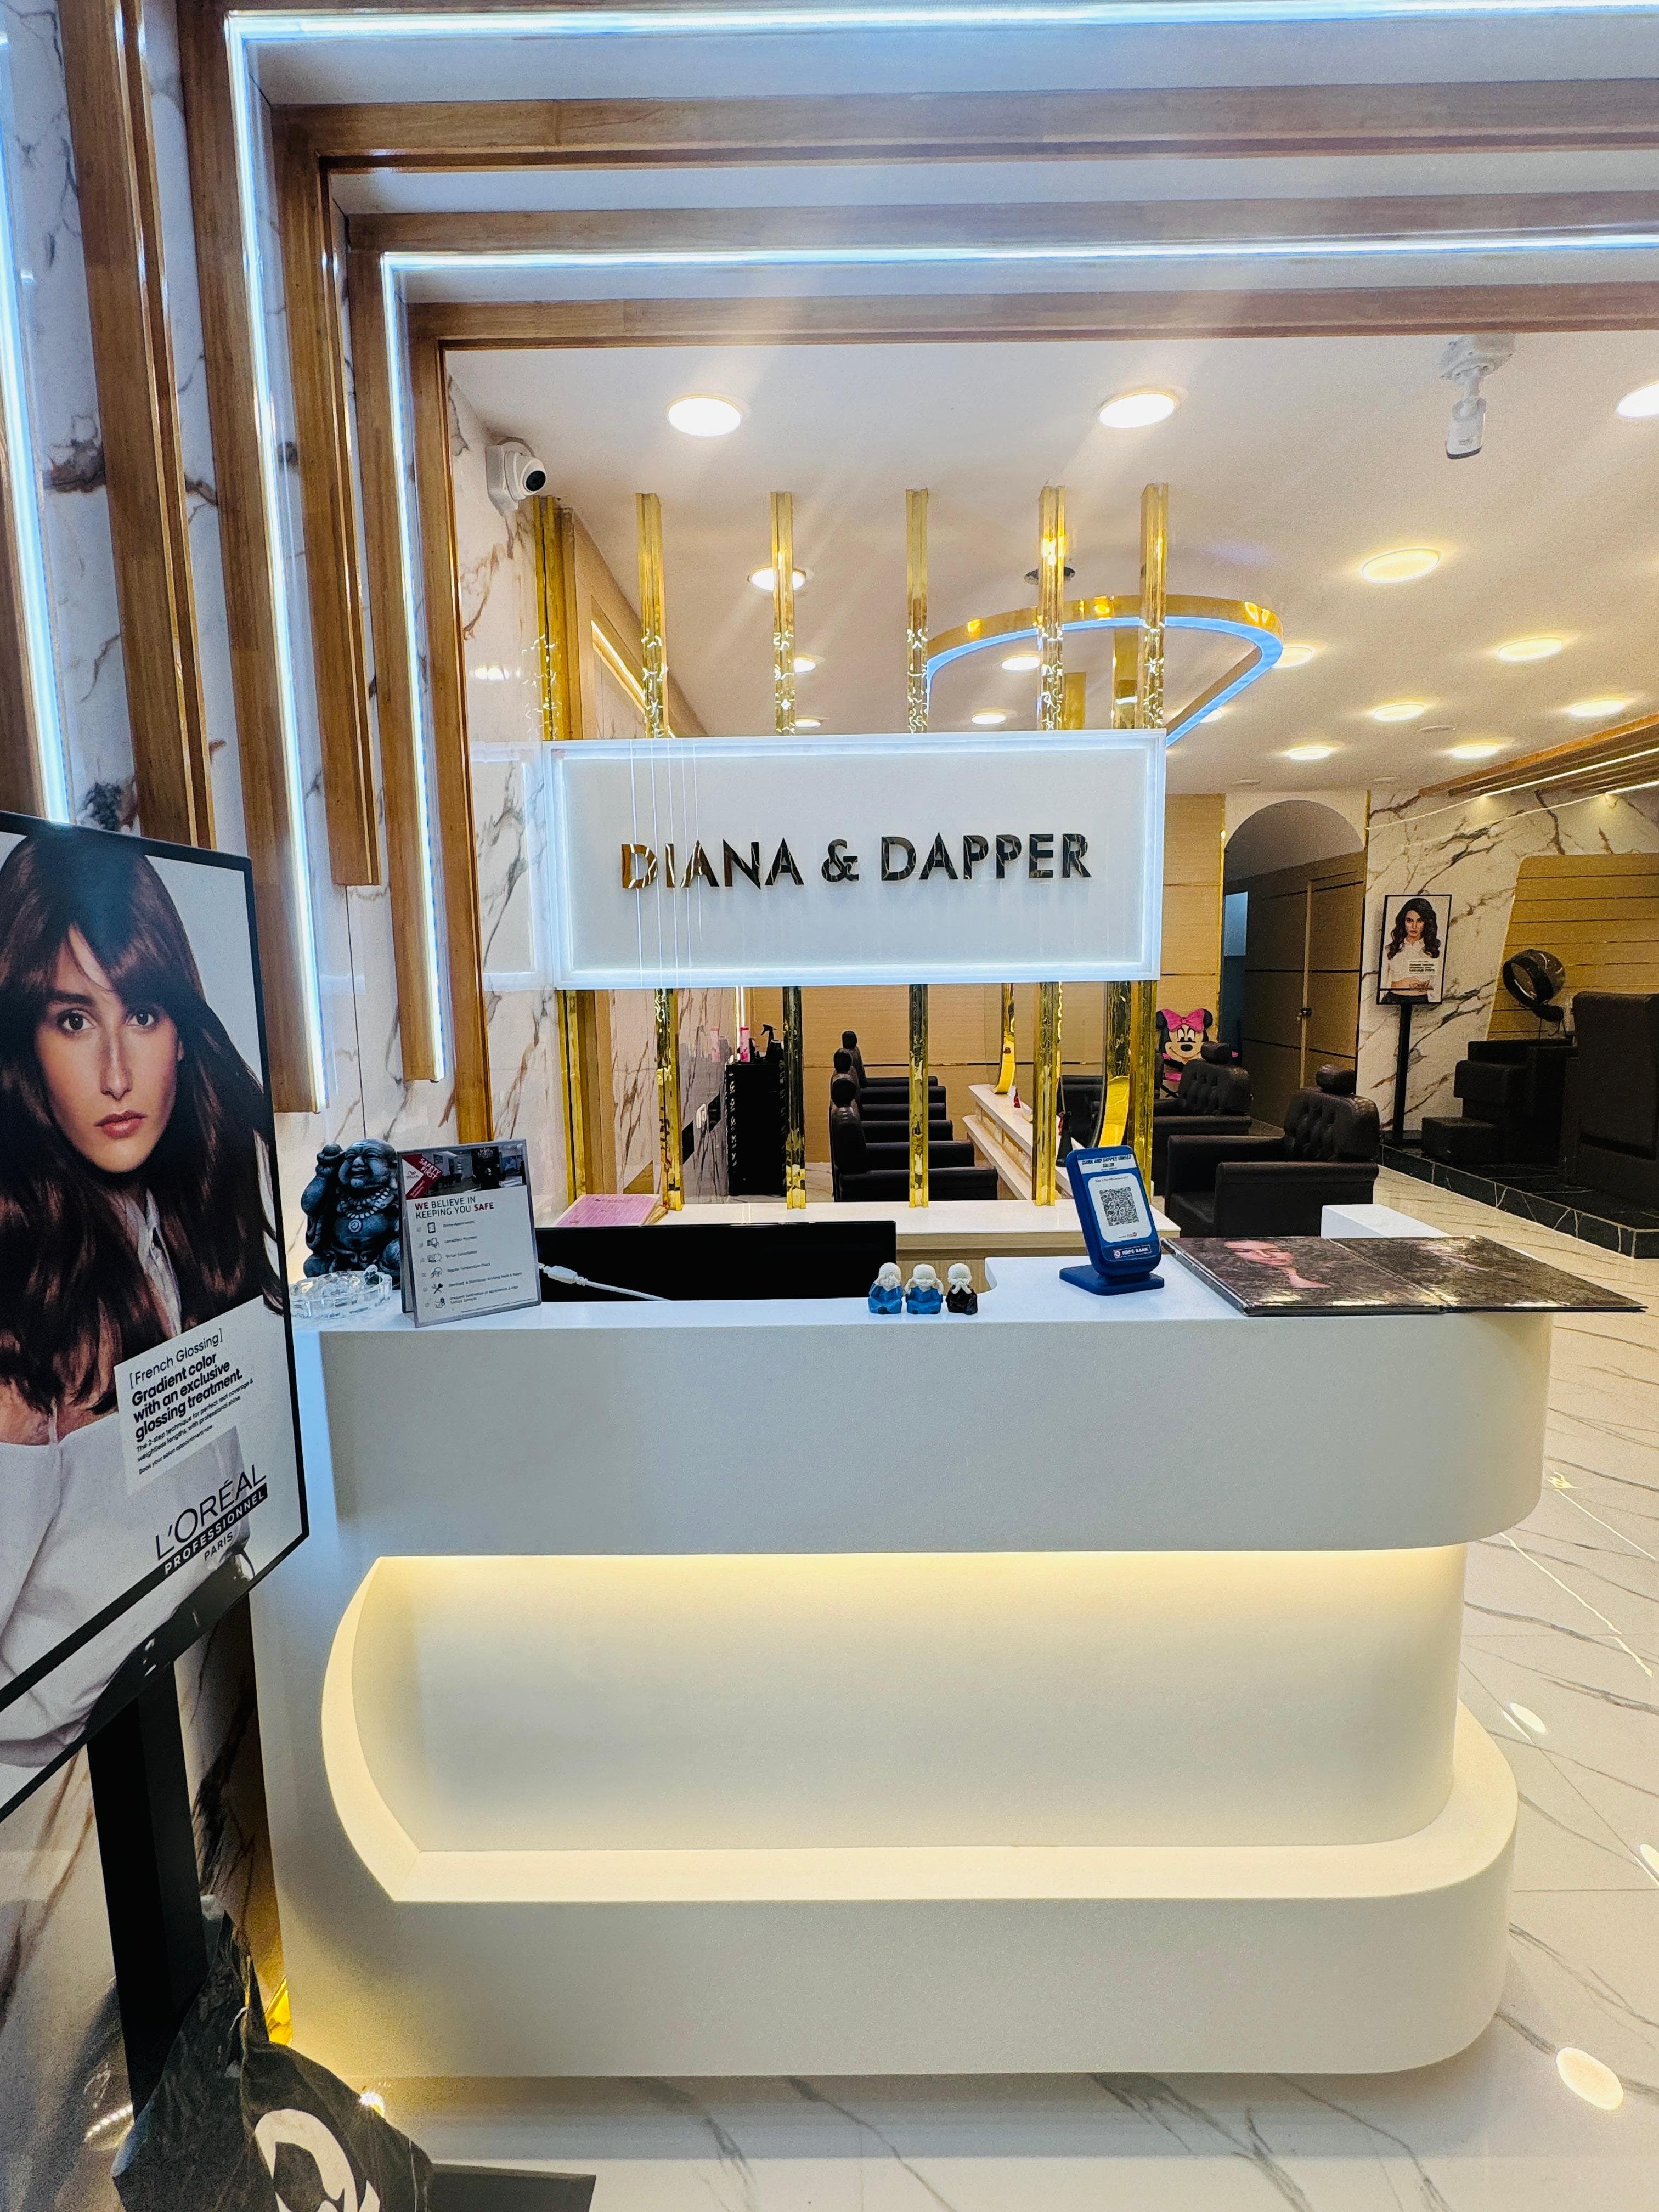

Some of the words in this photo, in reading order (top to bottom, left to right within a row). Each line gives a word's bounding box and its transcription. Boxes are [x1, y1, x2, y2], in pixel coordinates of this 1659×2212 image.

[621, 837, 804, 890] DIANA
[821, 839, 860, 882] &
[880, 832, 1093, 882] DAPPER
[419, 1158, 441, 1175] SAFETY
[420, 1167, 438, 1180] FIRST
[415, 1202, 428, 1210] WE
[431, 1197, 465, 1208] BELIEVE
[416, 1207, 452, 1219] KEEPING
[454, 1205, 471, 1214] YOU
[473, 1202, 494, 1211] SAFE
[176, 1328, 223, 1362] Glossing]
[132, 1367, 187, 1406] Gradient
[188, 1353, 217, 1376] color
[133, 1399, 161, 1423] with
[162, 1390, 178, 1406] an
[180, 1362, 230, 1396] exclusive
[136, 1402, 186, 1443] glossing
[187, 1368, 242, 1408] treatment.
[155, 1464, 267, 1561] L'ORÉAL
[165, 1491, 264, 1575] PROFESSIONNEL
[204, 1532, 233, 1561] PARIS
